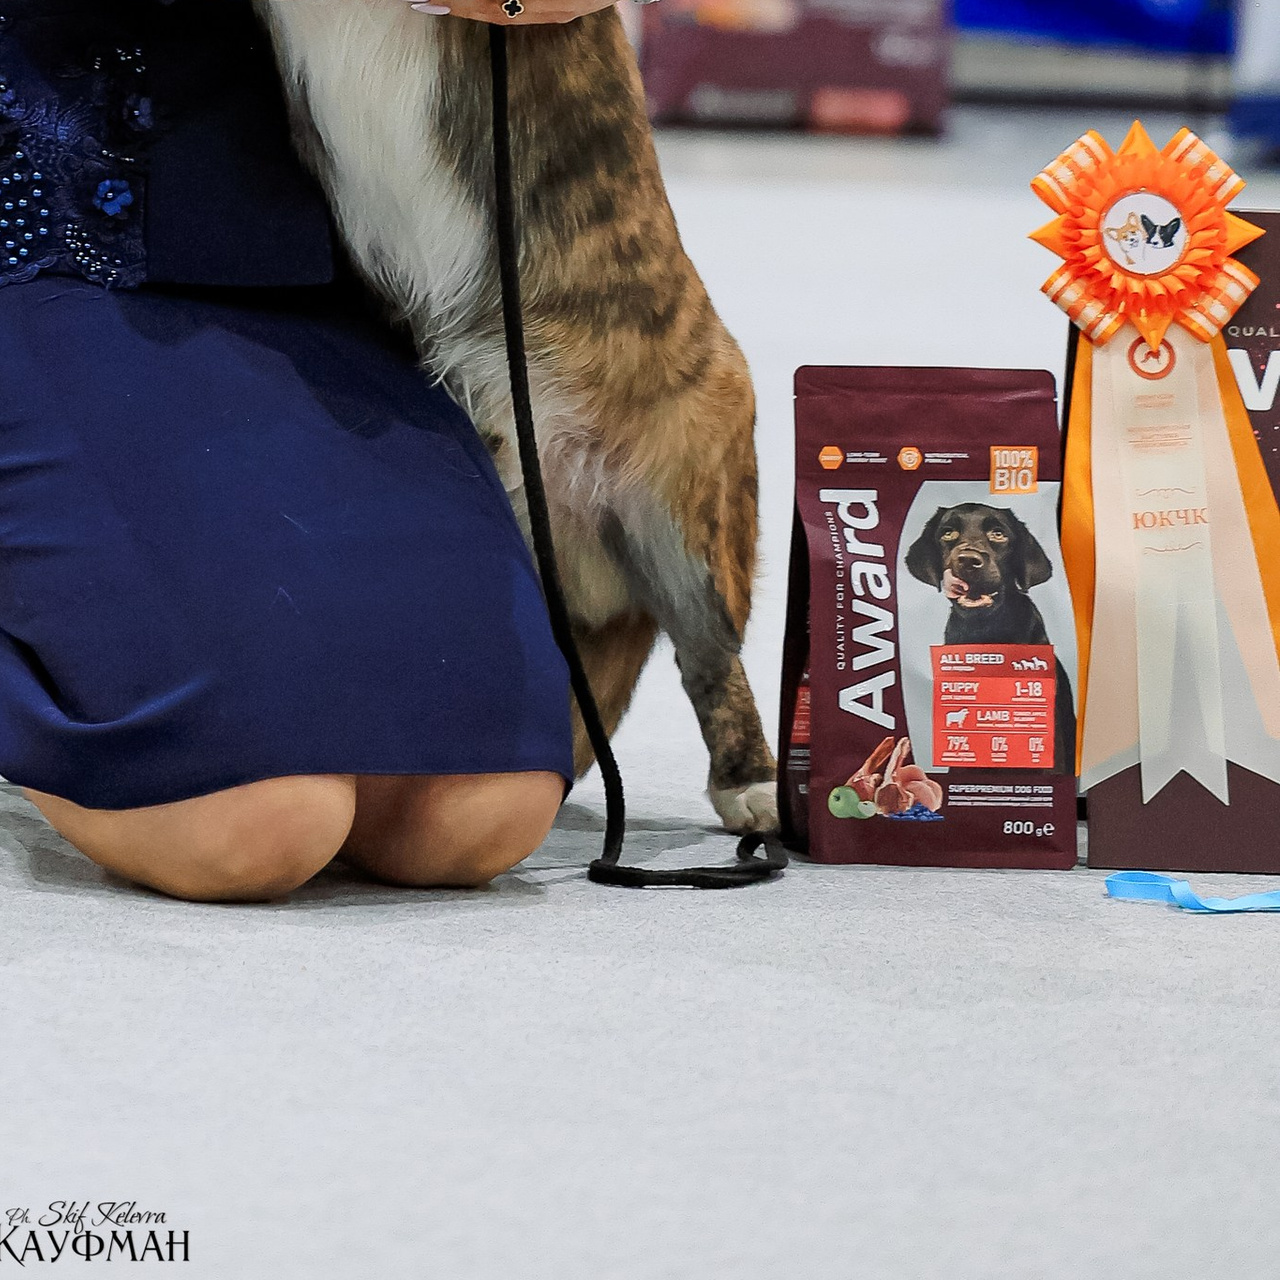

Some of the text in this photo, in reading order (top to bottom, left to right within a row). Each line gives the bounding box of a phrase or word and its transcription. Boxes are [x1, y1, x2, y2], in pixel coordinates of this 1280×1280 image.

[994, 449, 1034, 468] 100%
[994, 468, 1033, 490] BIO
[1132, 507, 1209, 530] ЮКЧК
[823, 510, 846, 671] QUALITY FOR CHAMPIONS
[819, 488, 897, 731] Award
[940, 652, 1005, 665] ALL BREED
[941, 681, 980, 693] PUPPY
[976, 710, 1010, 722] LAMB
[1003, 821, 1034, 835] 800
